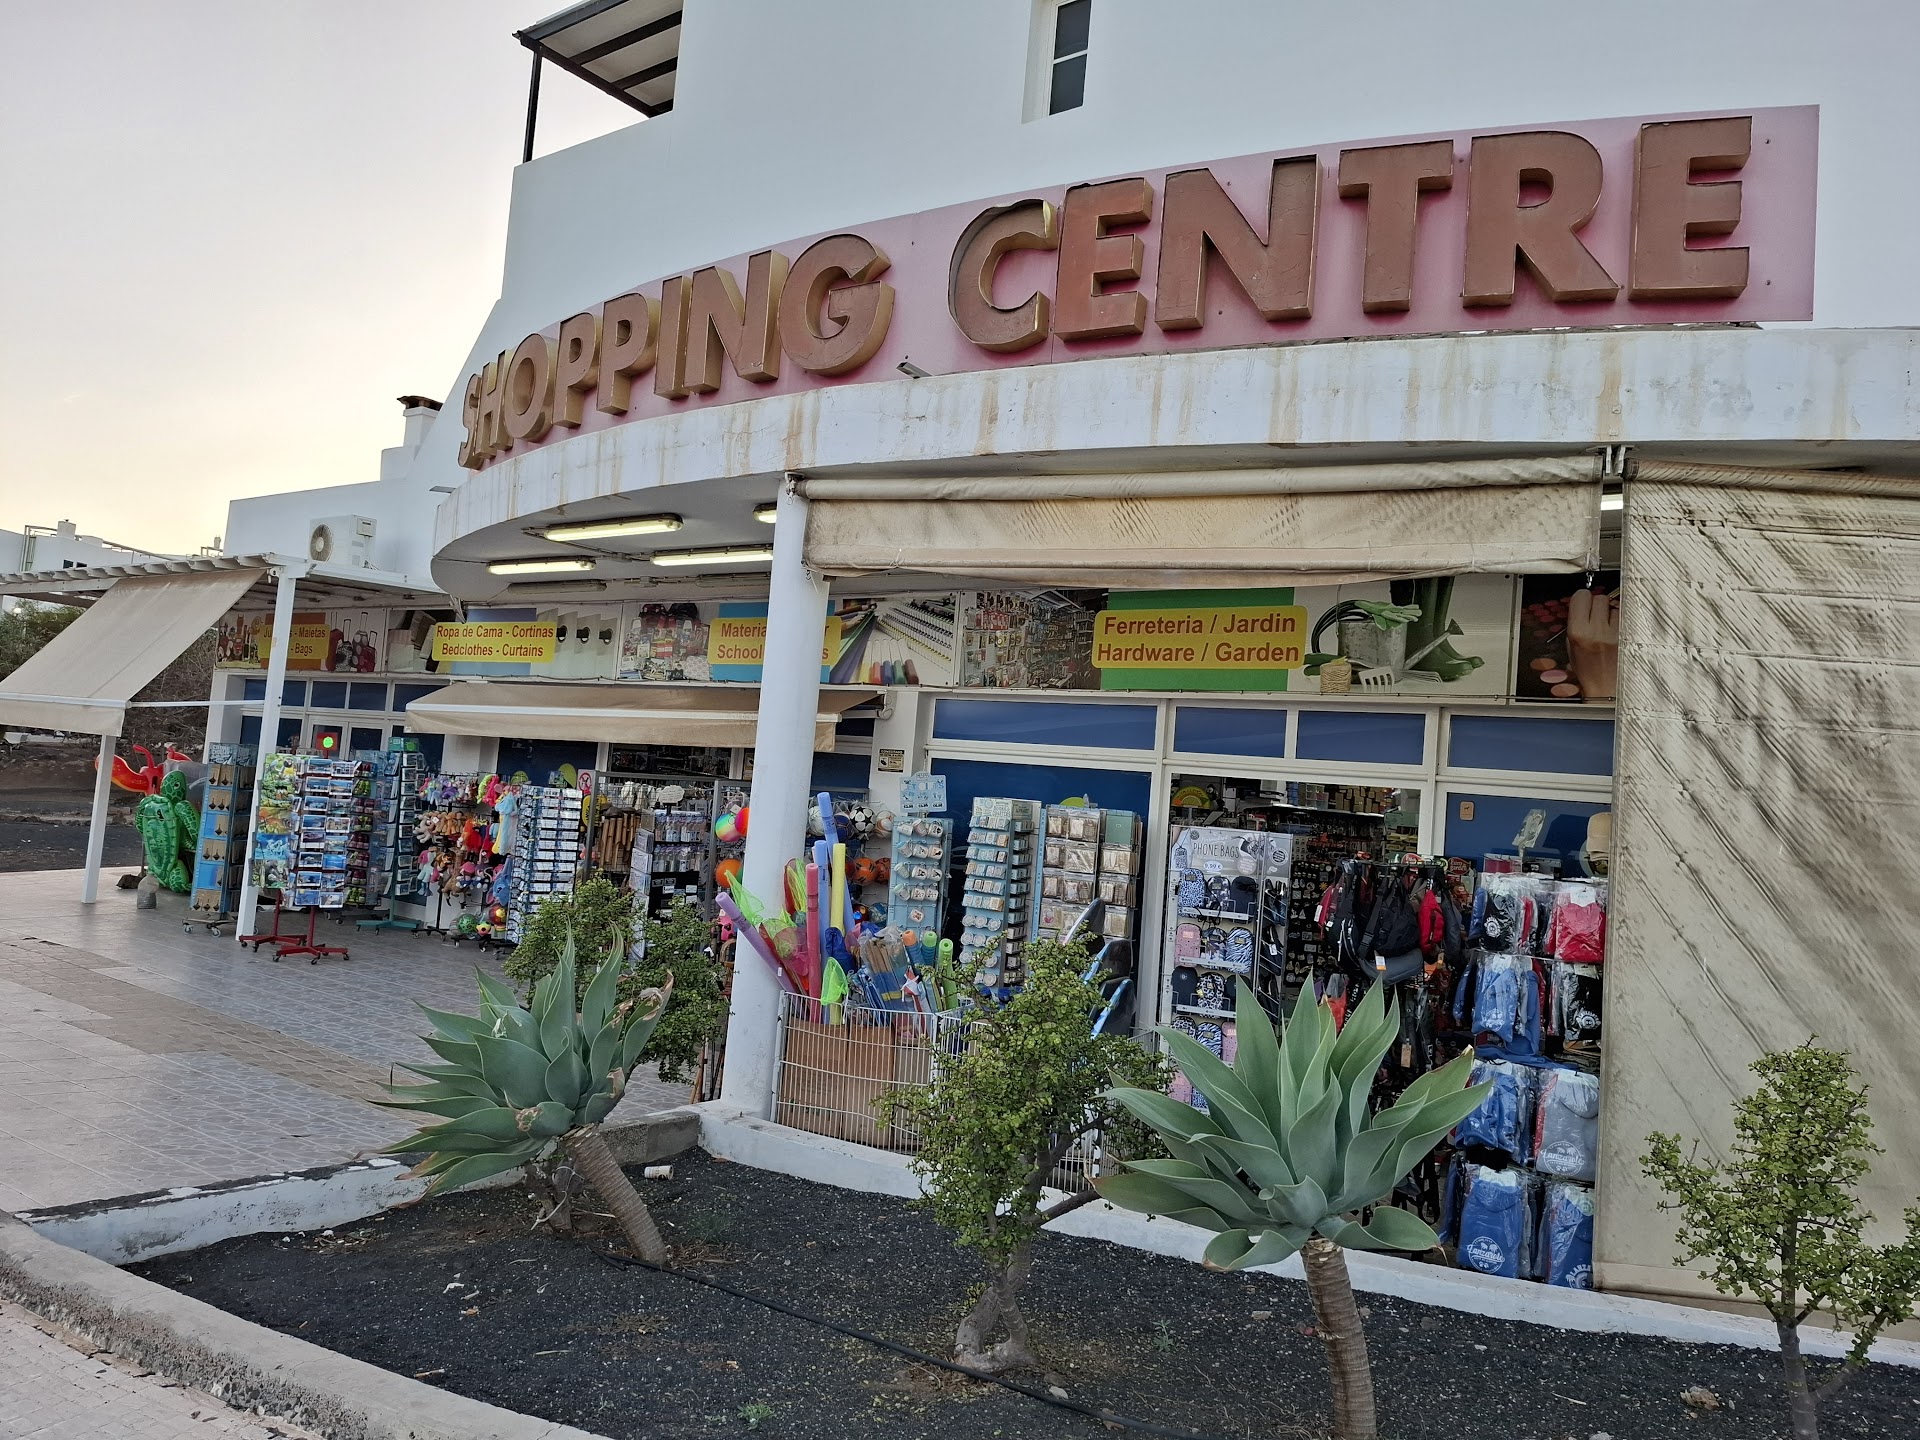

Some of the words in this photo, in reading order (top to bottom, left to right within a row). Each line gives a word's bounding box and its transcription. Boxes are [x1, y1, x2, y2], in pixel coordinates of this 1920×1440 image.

[458, 233, 895, 470] SHOPPING
[947, 116, 1753, 353] CENTRE
[721, 623, 767, 637] Materia
[1104, 615, 1203, 634] Ferreteria
[1210, 614, 1218, 634] /
[1223, 613, 1296, 633] Jardin
[298, 627, 326, 638] Maletas
[436, 625, 459, 640] Ropa
[462, 626, 473, 637] de
[476, 625, 503, 638] Cama
[512, 625, 553, 638] Cortinas
[294, 643, 313, 656] Bags
[442, 643, 493, 656] Bedclothes
[502, 644, 543, 656] Curtains
[717, 644, 763, 659] School
[1097, 644, 1195, 662] Hardware
[1201, 643, 1209, 662] /
[1215, 642, 1299, 662] Garden
[1193, 842, 1218, 857] PHONE
[1220, 846, 1239, 858] BAGS
